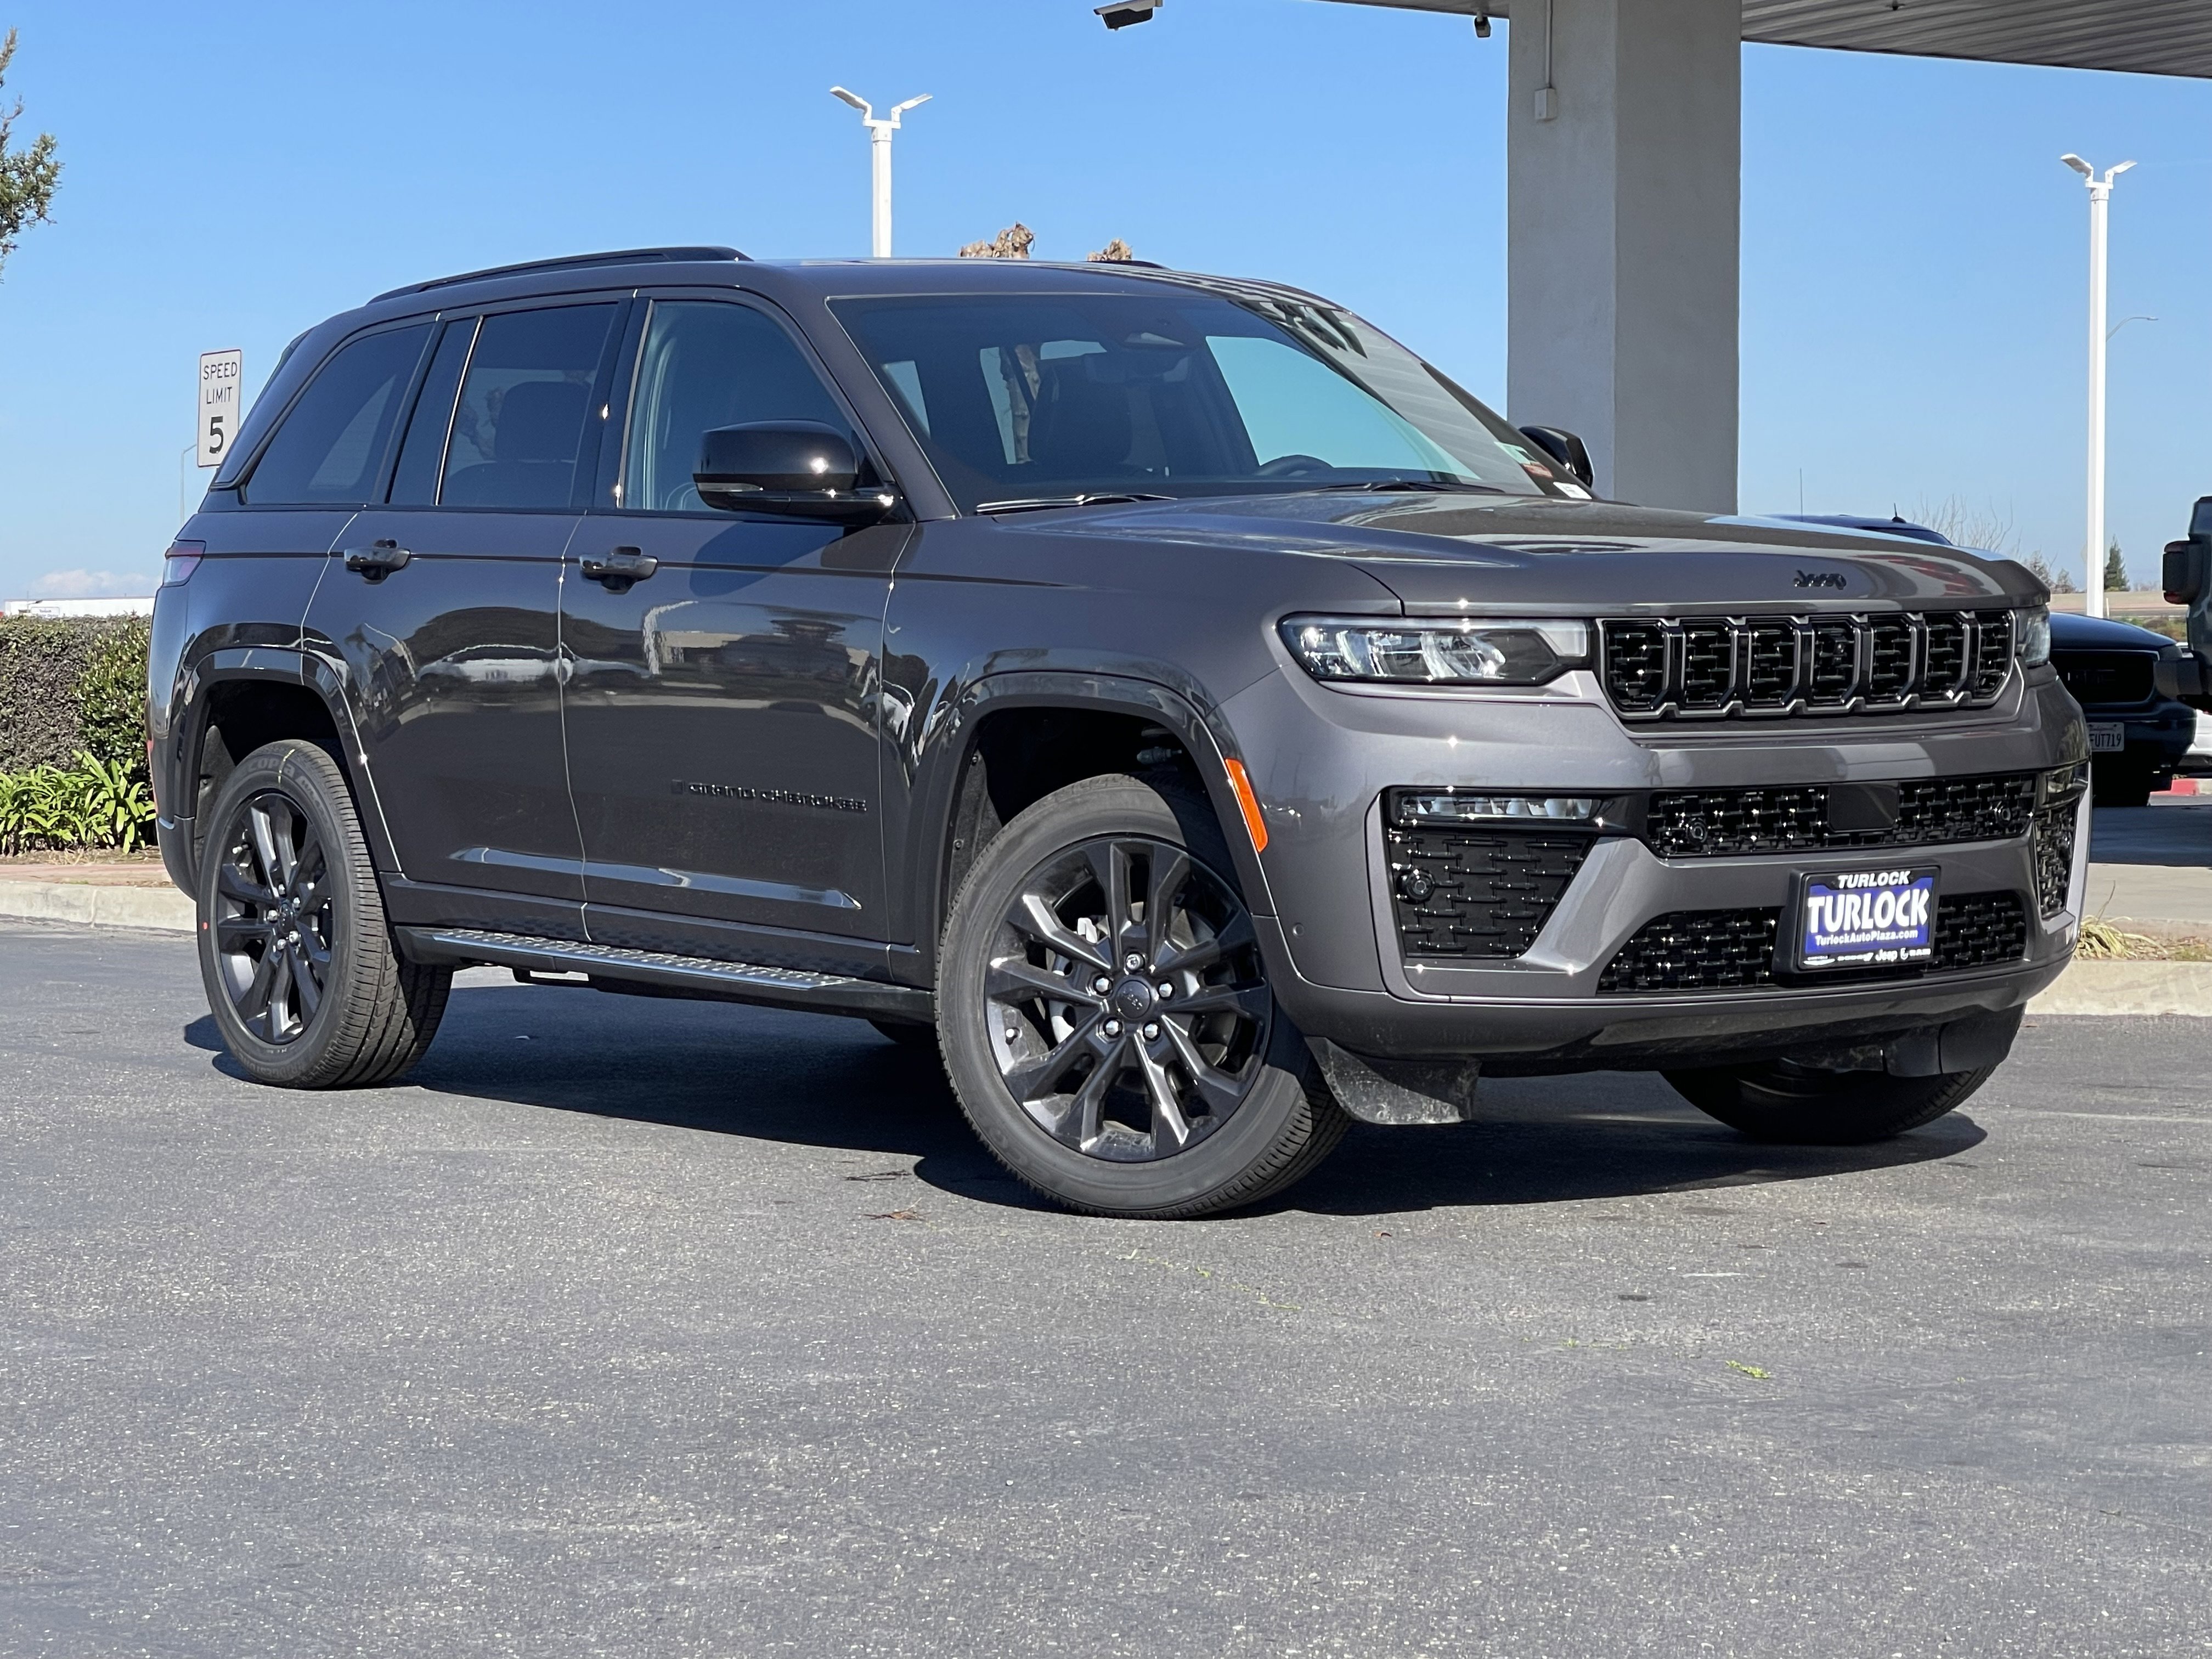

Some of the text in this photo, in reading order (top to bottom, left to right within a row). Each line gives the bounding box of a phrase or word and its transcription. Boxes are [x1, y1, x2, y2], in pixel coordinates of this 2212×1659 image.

[204, 362, 237, 380] SPEED
[206, 386, 232, 404] LIMIT
[209, 416, 224, 454] 5
[761, 790, 868, 812] CHEROKEE
[1838, 871, 1911, 888] TURLOCK
[1808, 888, 1930, 933] TURLOCK
[1815, 930, 1918, 946] TurlockAutoPlaza.com
[1875, 949, 1898, 962] Jeep
